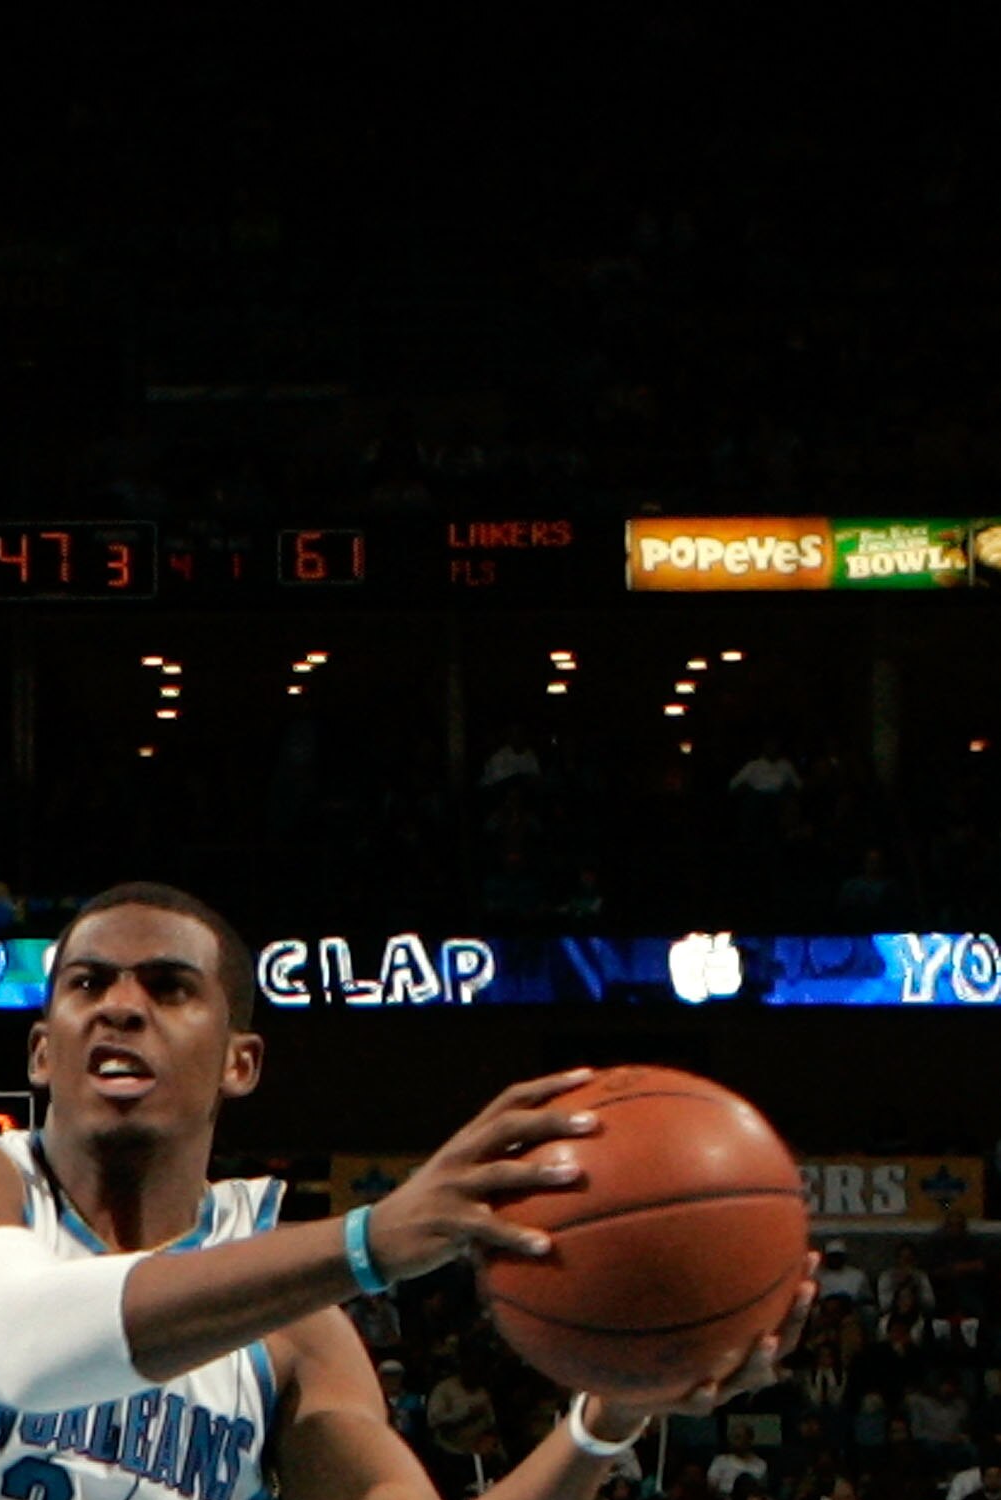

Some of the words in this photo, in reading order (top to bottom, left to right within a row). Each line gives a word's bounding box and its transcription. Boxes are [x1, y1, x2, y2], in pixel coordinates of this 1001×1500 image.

[106, 542, 133, 589] 3
[293, 530, 367, 581] 61
[846, 545, 953, 579] BOWL
[257, 932, 496, 1006] CLAP
